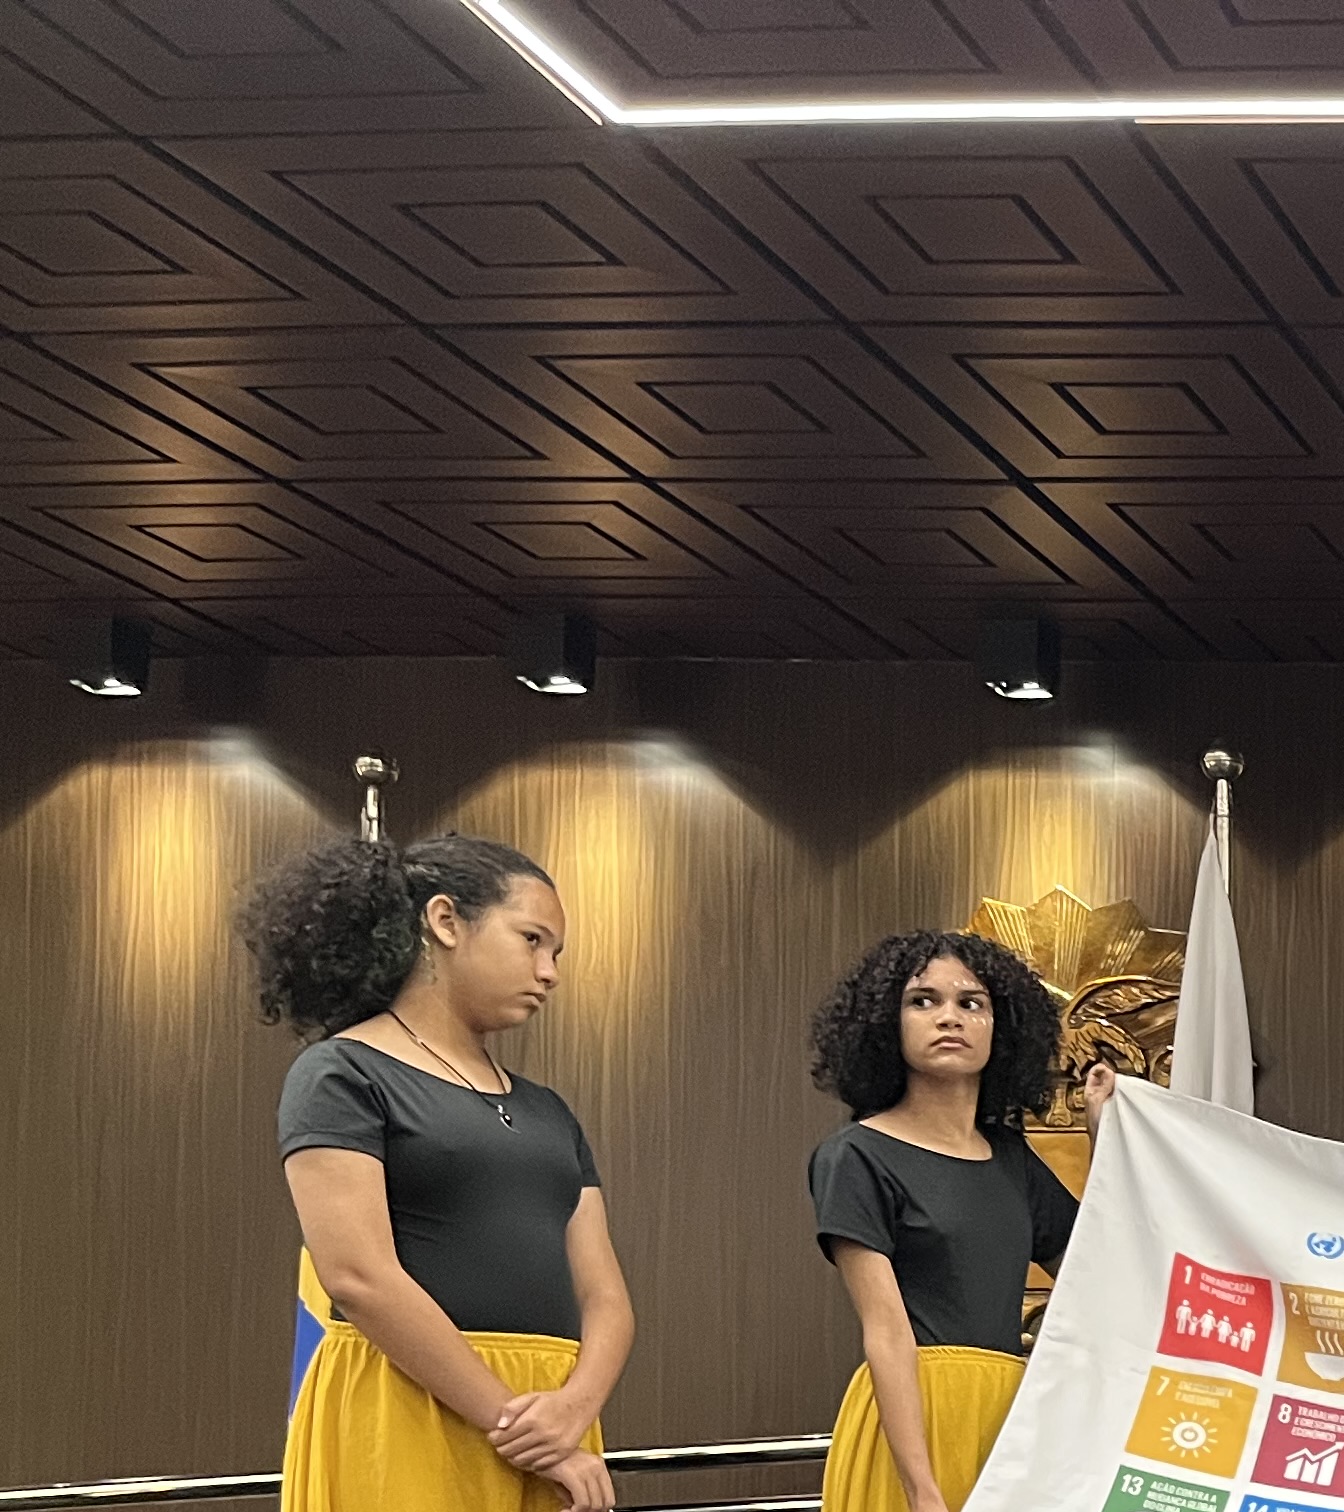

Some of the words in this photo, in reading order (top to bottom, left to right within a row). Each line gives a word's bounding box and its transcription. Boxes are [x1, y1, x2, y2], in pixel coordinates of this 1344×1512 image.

[1156, 1375, 1170, 1395] 7
[1277, 1403, 1292, 1424] 8
[1120, 1474, 1144, 1496] 13
